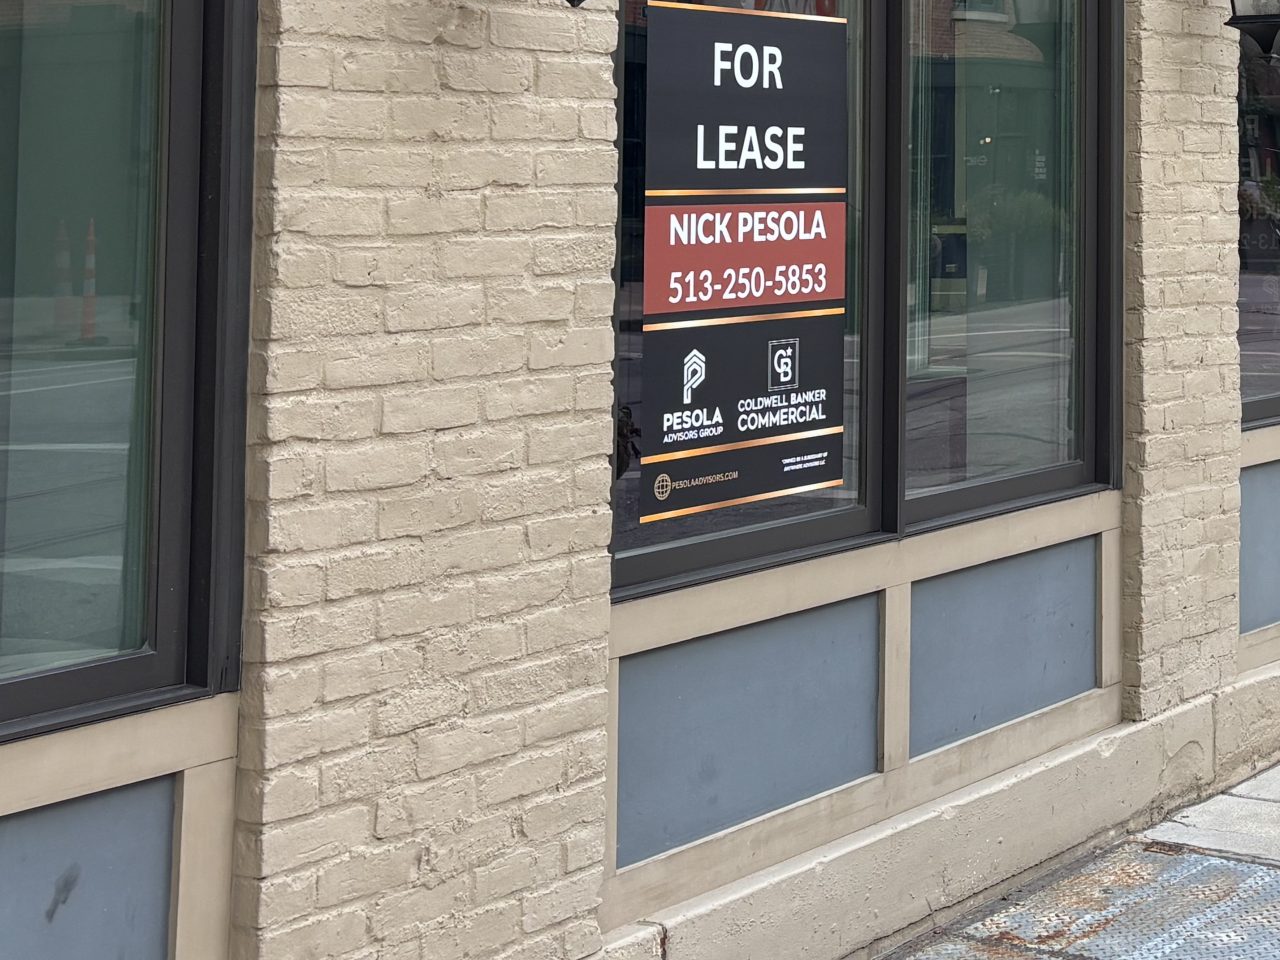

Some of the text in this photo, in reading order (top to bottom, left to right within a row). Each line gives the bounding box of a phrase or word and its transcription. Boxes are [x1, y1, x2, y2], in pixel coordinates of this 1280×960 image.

[713, 41, 783, 90] FOR
[696, 124, 806, 170] LEASE
[669, 210, 827, 246] NICK PESOLA
[668, 263, 827, 304] 513-250-5853
[737, 389, 826, 412] COLDWELL BANKER
[662, 406, 724, 432] PESOLA
[737, 403, 827, 432] COMMERCIAL
[662, 426, 724, 444] ADVISORS GROUP
[671, 471, 739, 490] PESOLAADVISORS.COM
